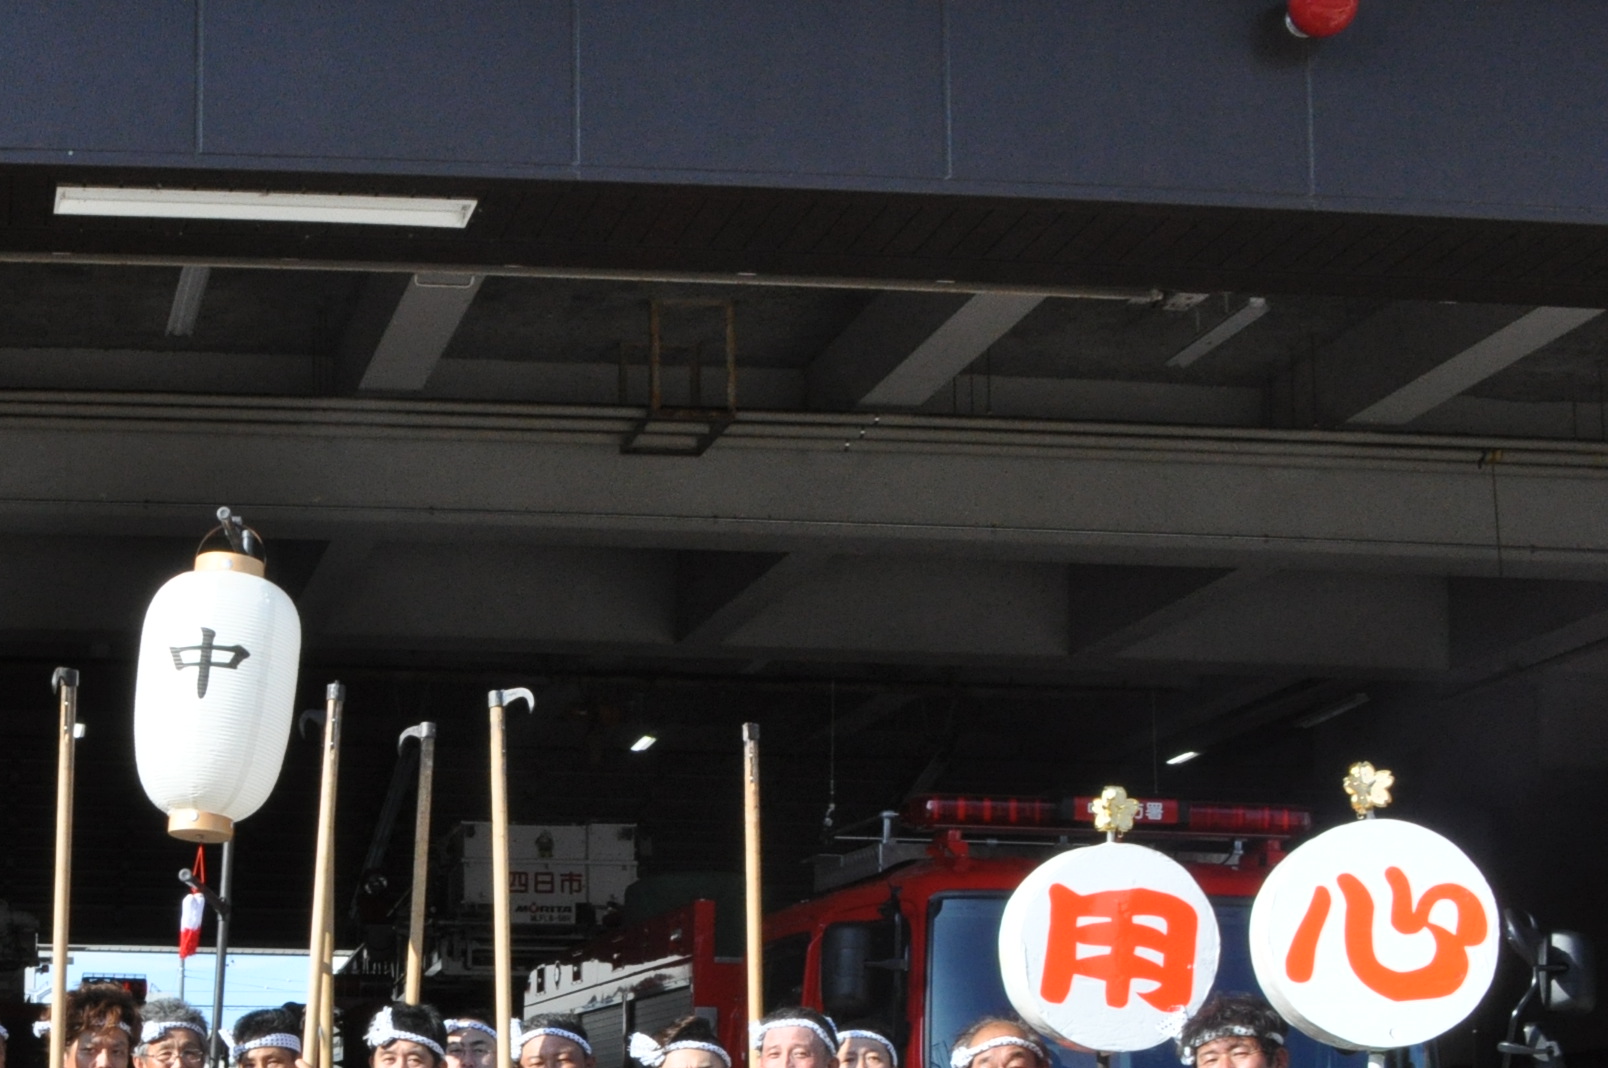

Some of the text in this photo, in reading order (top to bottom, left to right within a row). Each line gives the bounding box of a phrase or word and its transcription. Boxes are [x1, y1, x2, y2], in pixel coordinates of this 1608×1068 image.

[170, 627, 250, 699] 中
[509, 871, 583, 895] 四日市
[516, 904, 571, 913] MORITA
[1041, 884, 1198, 1012] 用
[1287, 867, 1486, 1001] 心
